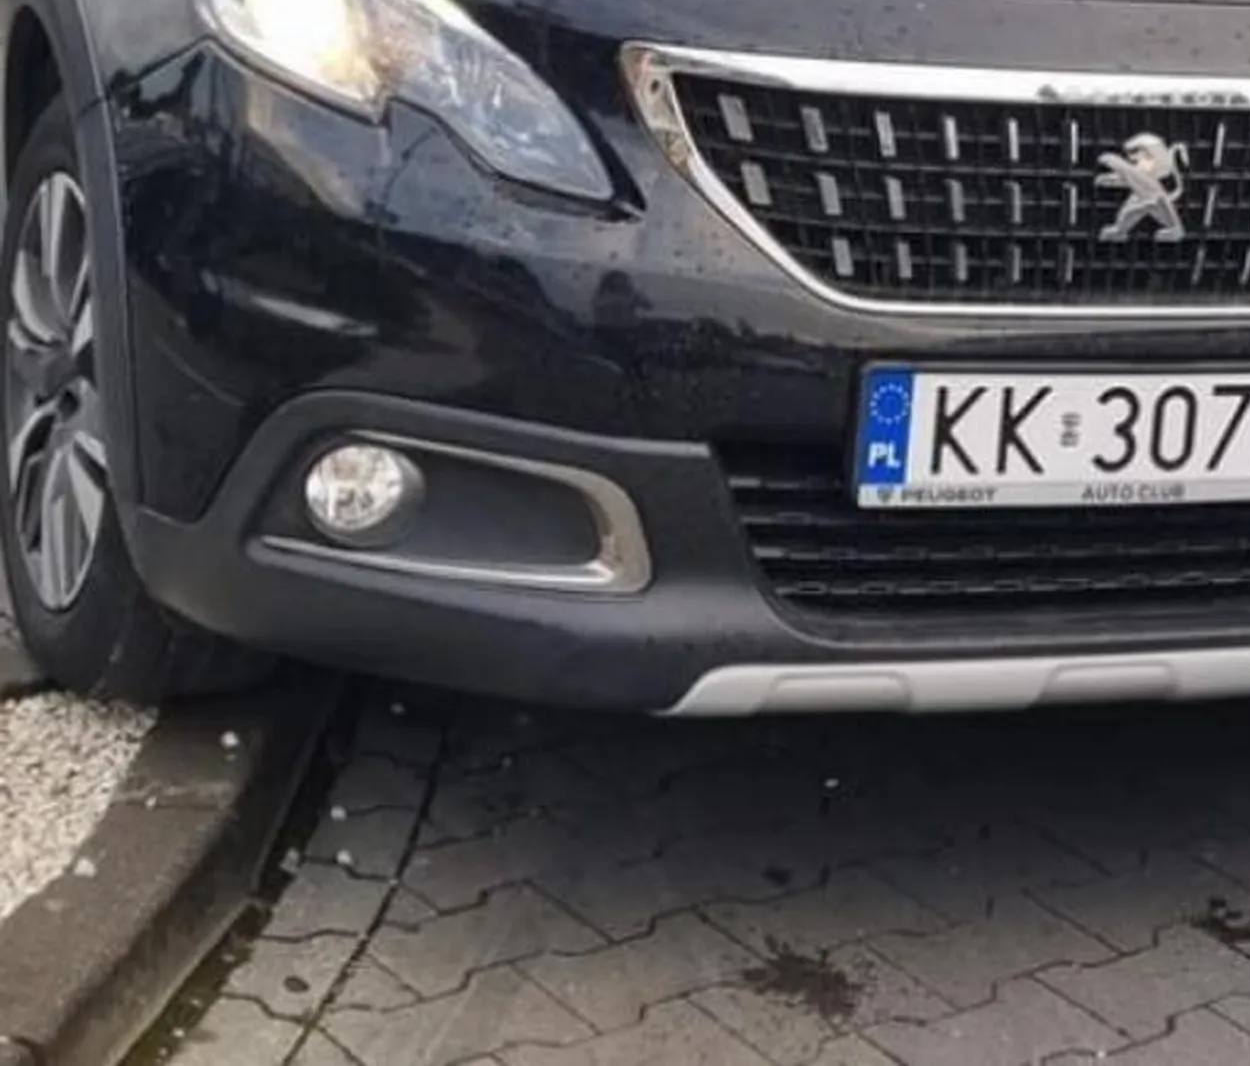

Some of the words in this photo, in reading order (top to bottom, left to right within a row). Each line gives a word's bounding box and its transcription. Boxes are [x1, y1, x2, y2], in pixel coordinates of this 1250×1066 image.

[930, 385, 1053, 475] KK
[867, 441, 901, 469] PL
[1080, 483, 1135, 500] AUTO
[1138, 481, 1187, 498] CLUB
